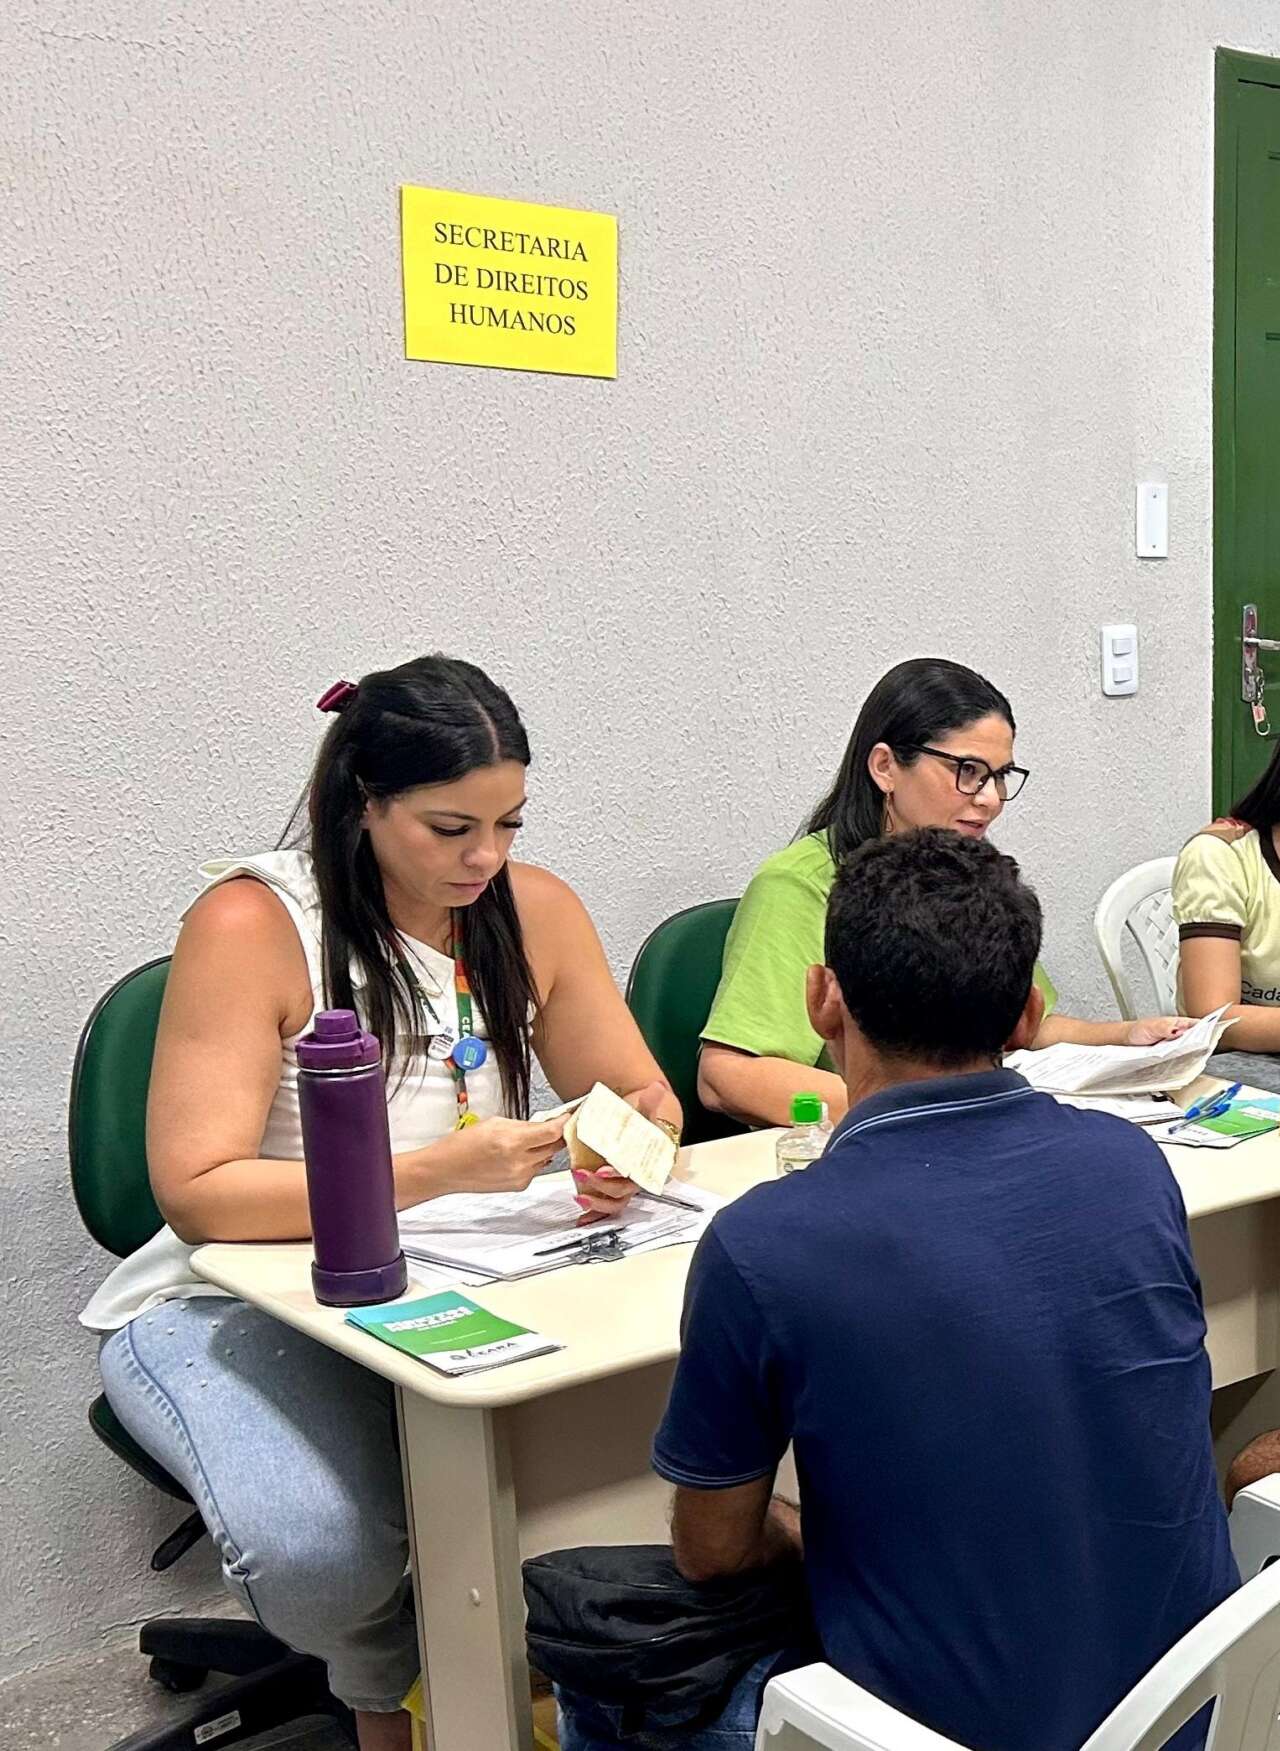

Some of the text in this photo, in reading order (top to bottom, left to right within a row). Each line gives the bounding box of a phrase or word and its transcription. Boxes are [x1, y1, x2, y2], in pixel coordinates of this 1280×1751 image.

[434, 221, 589, 263] SECRETARIA
[435, 262, 589, 301] DE DIREITOS
[449, 302, 577, 336] HUMANOS
